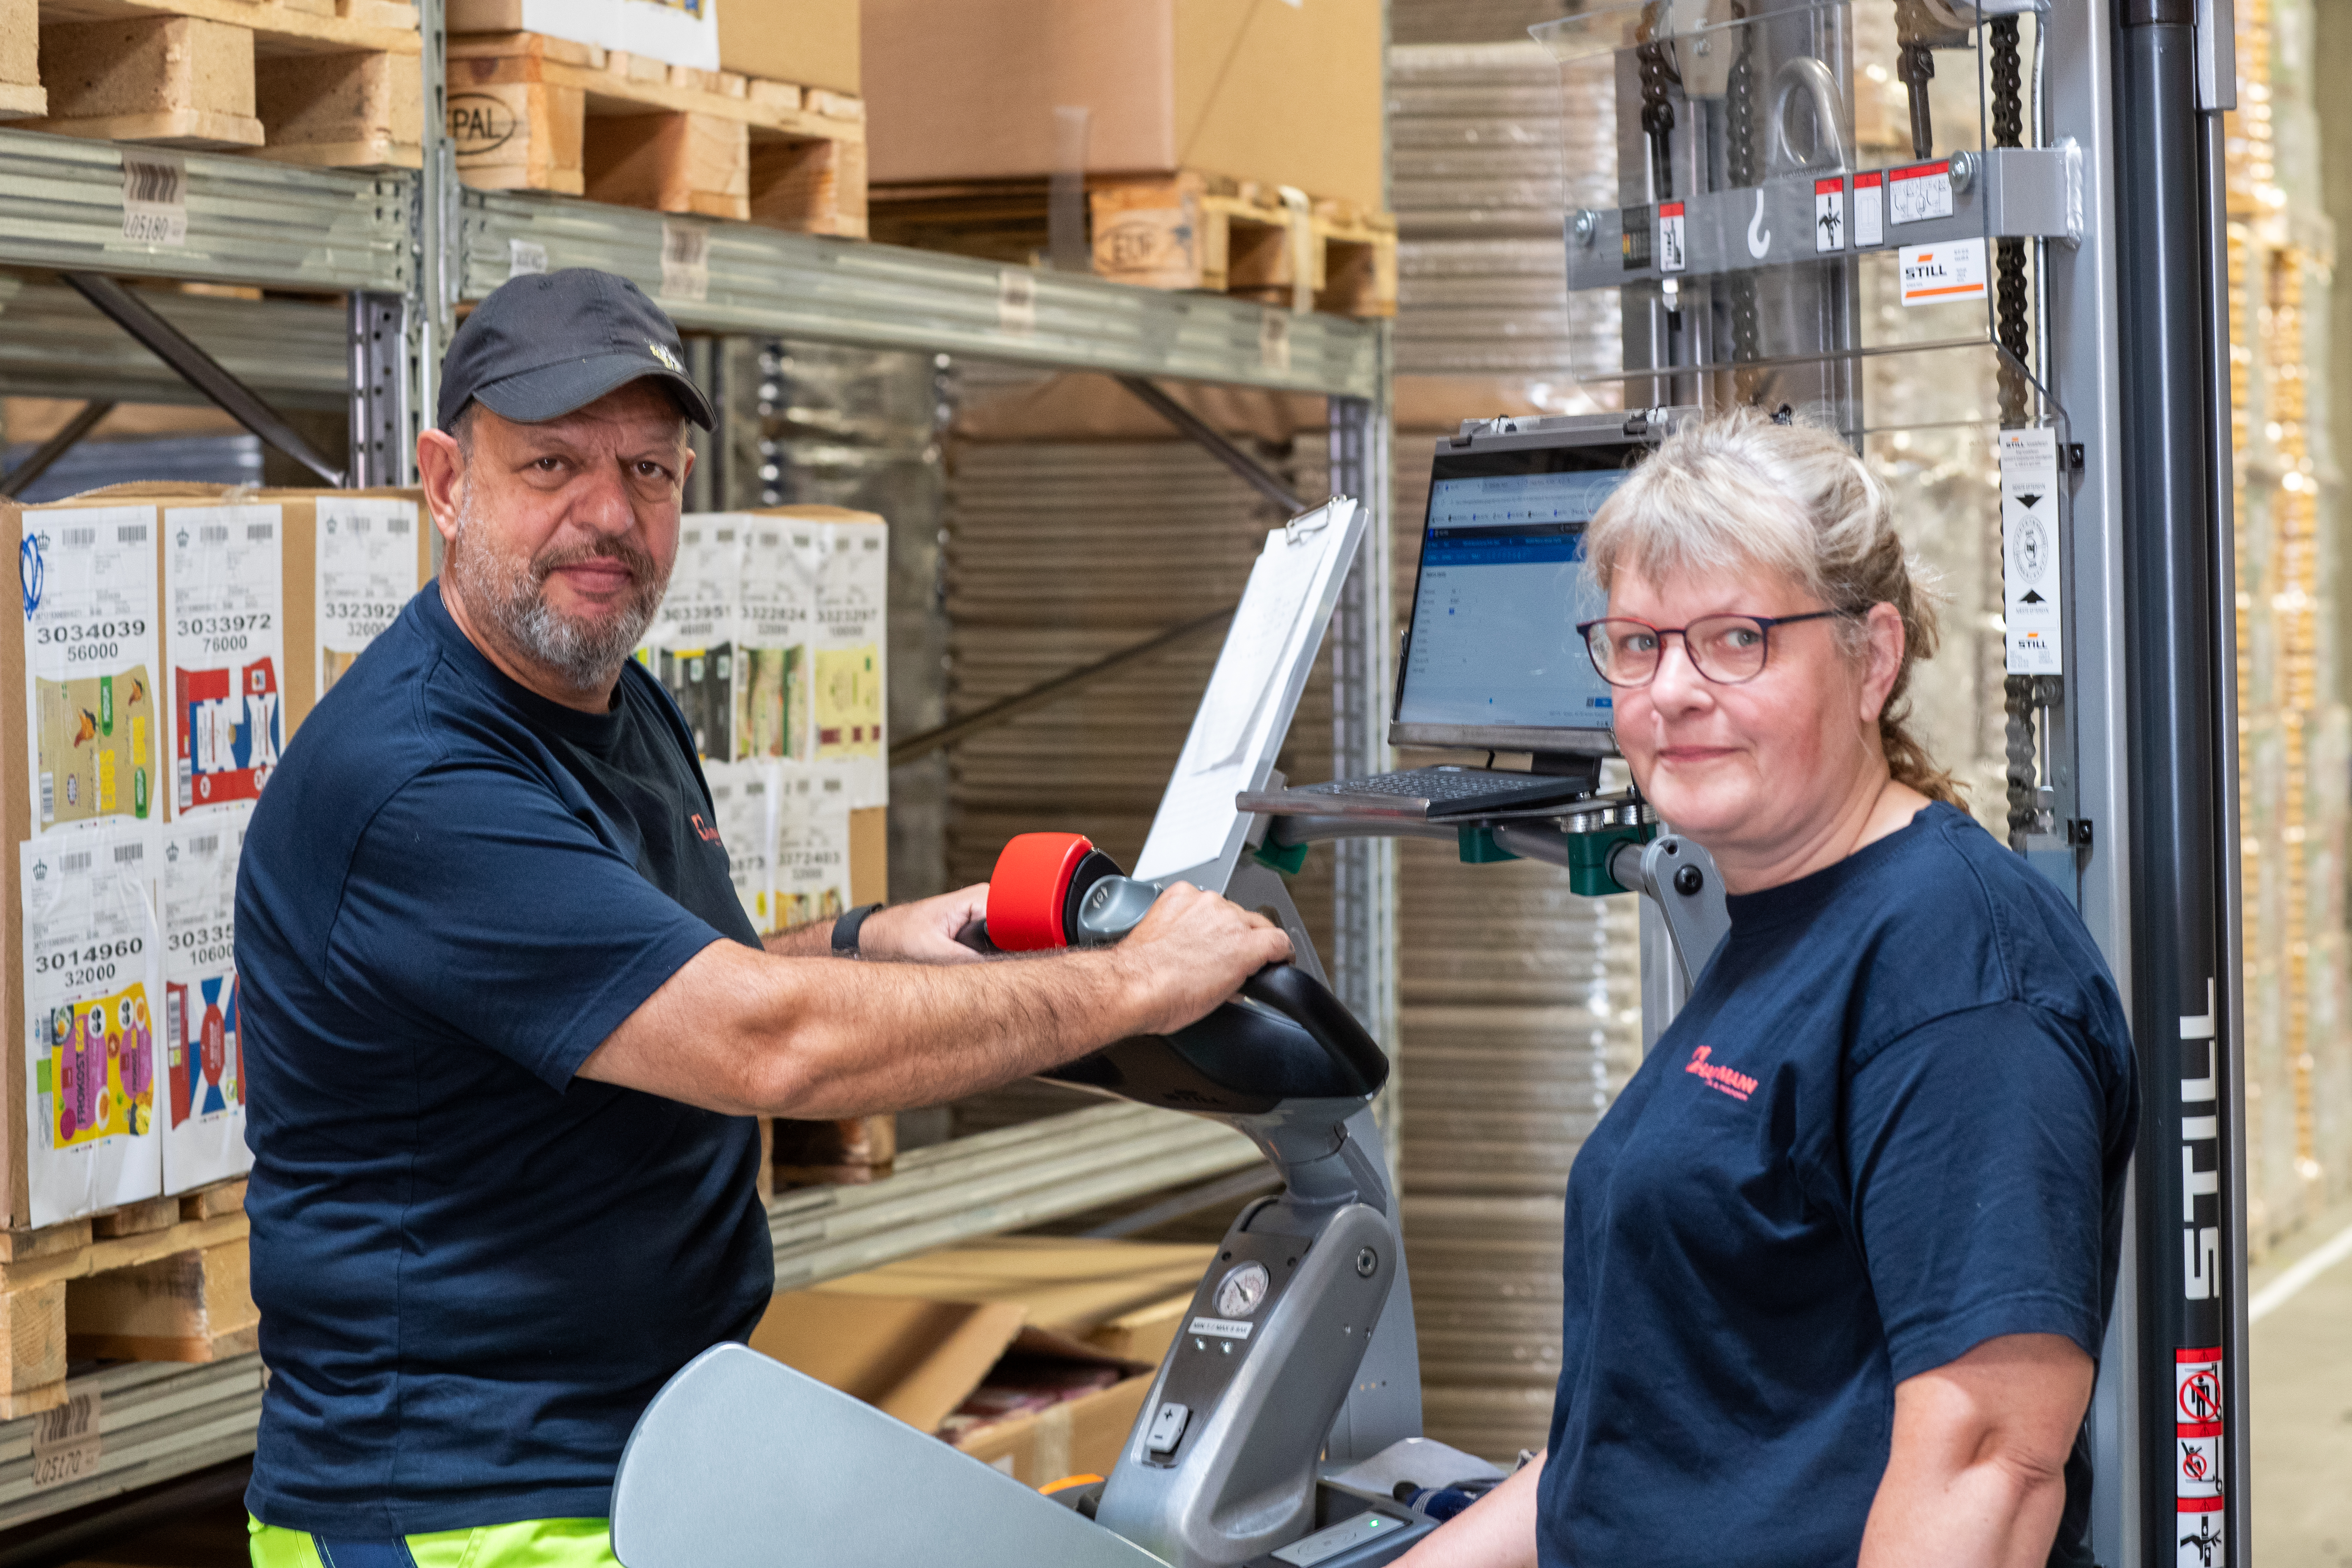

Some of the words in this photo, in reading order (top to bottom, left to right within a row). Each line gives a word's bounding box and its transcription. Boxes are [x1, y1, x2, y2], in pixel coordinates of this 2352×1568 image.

[1905, 263, 1947, 280] STILL
[37, 619, 145, 645] 3034039
[177, 612, 271, 637] 3033972
[68, 642, 118, 662] 56000
[203, 634, 248, 653] 76000
[2018, 639, 2048, 649] STILL
[35, 936, 143, 974] 3014960
[65, 962, 116, 988] 32000
[2180, 977, 2220, 1299] STILL
